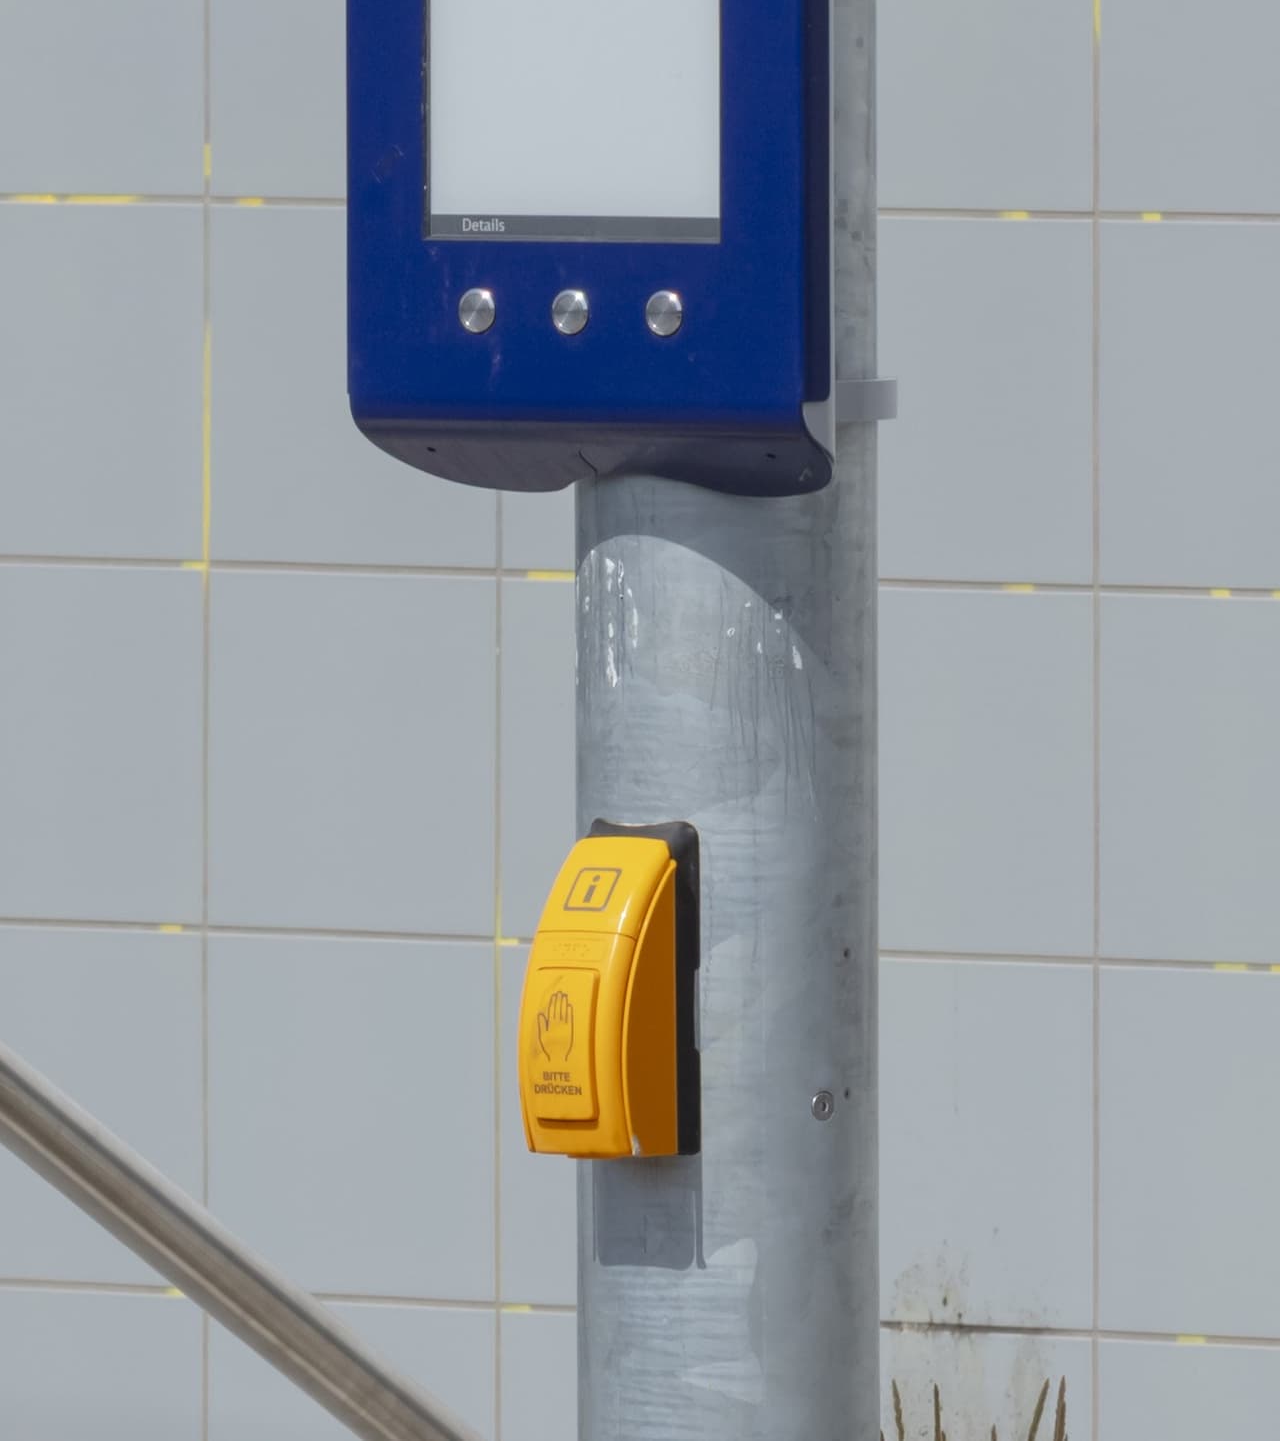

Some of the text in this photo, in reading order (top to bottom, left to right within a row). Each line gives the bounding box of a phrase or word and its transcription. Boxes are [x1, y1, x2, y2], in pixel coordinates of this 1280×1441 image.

[462, 218, 505, 232] Details
[543, 1071, 571, 1082] BITTE
[534, 1083, 582, 1095] DRÜCKEN
